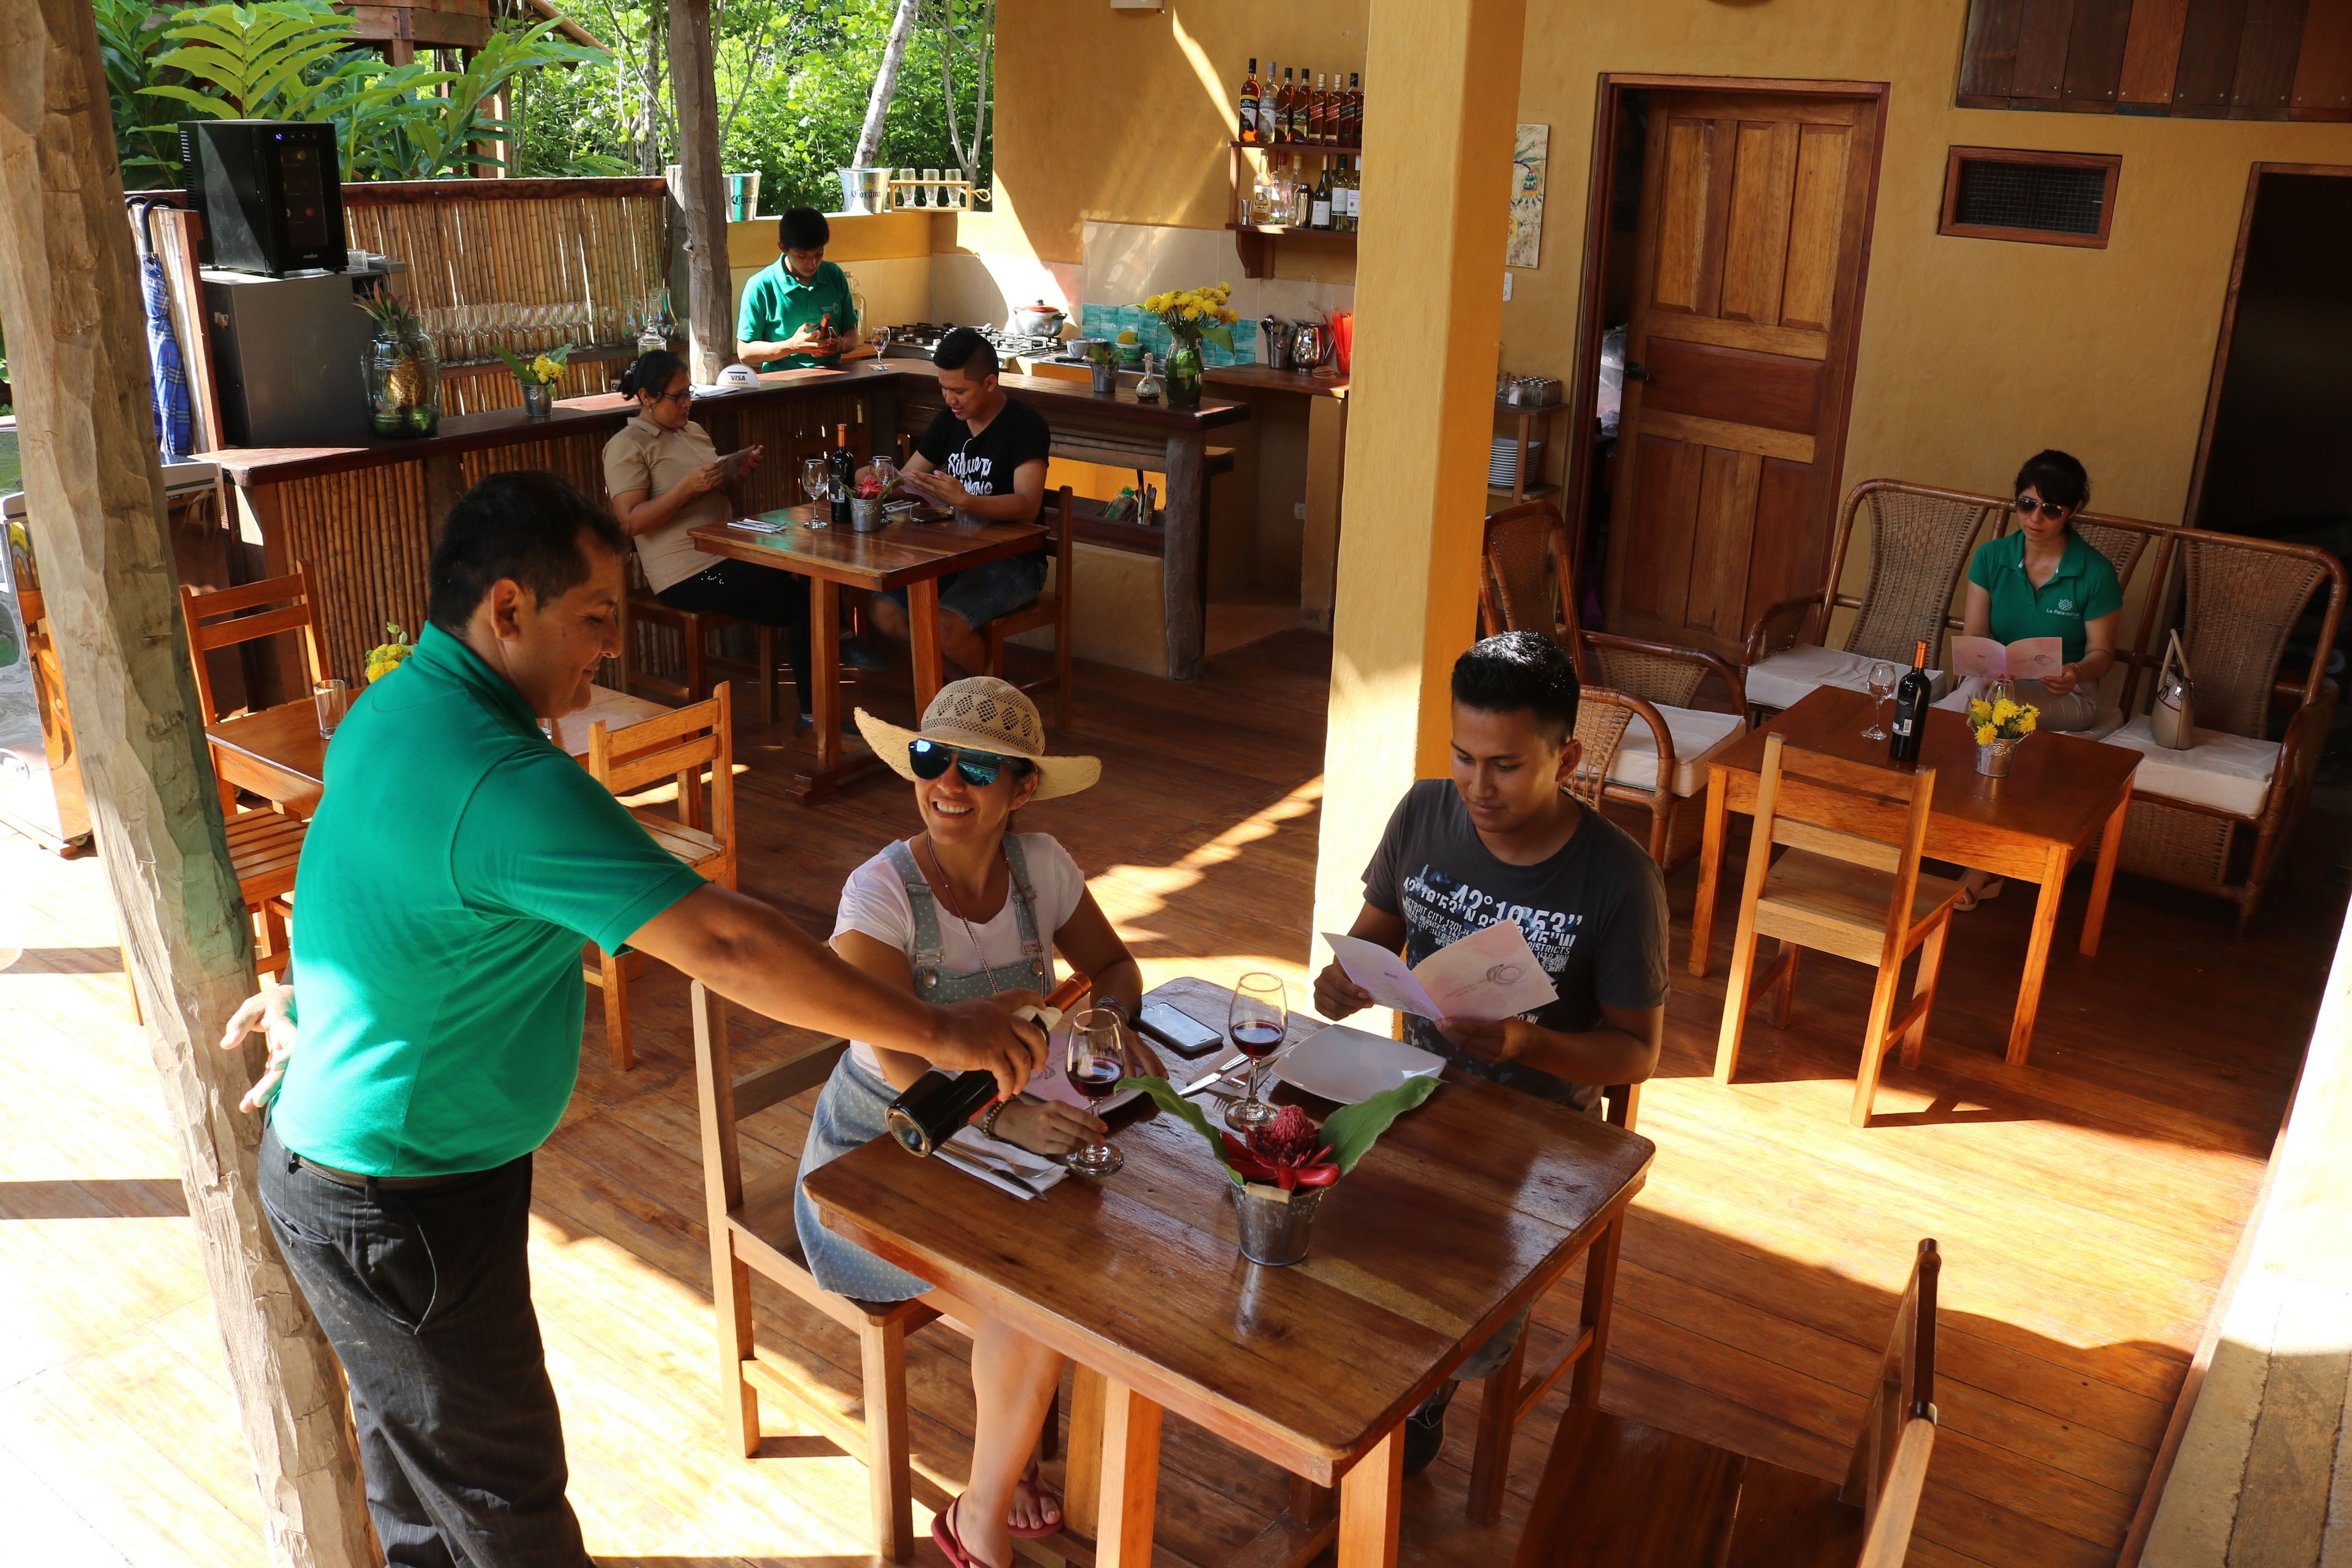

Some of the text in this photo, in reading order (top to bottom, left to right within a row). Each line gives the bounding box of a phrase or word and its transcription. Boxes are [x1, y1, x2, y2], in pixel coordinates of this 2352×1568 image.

[851, 189, 881, 198] Corona
[1405, 895, 1427, 915] DETROIT
[1428, 910, 1444, 924] CITY
[1418, 921, 1428, 930] CITY
